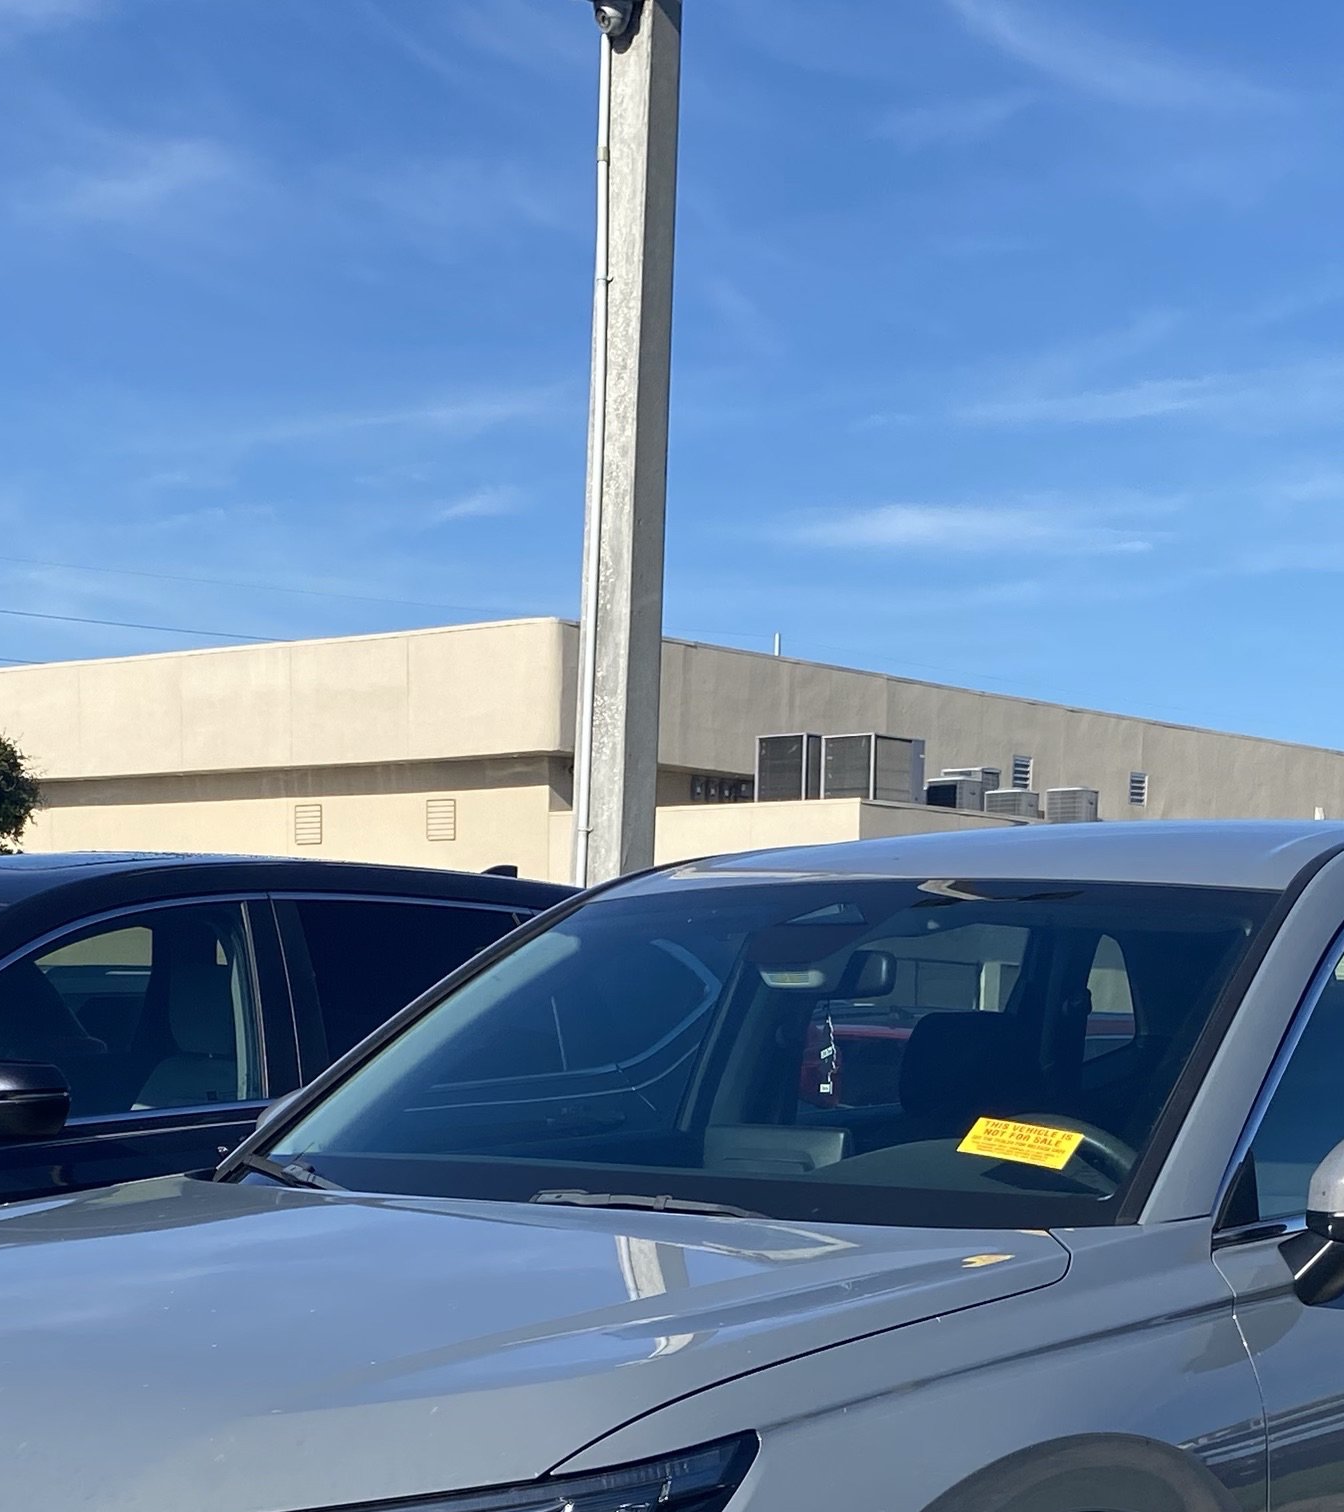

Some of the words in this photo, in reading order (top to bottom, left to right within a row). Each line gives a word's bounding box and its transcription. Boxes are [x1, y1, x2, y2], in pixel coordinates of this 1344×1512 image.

[983, 1128, 1007, 1138] NOT
[1009, 1132, 1031, 1142] FOR
[1033, 1136, 1063, 1147] SALE
[985, 1120, 1010, 1130] THIS
[1012, 1125, 1059, 1138] VEHICLE
